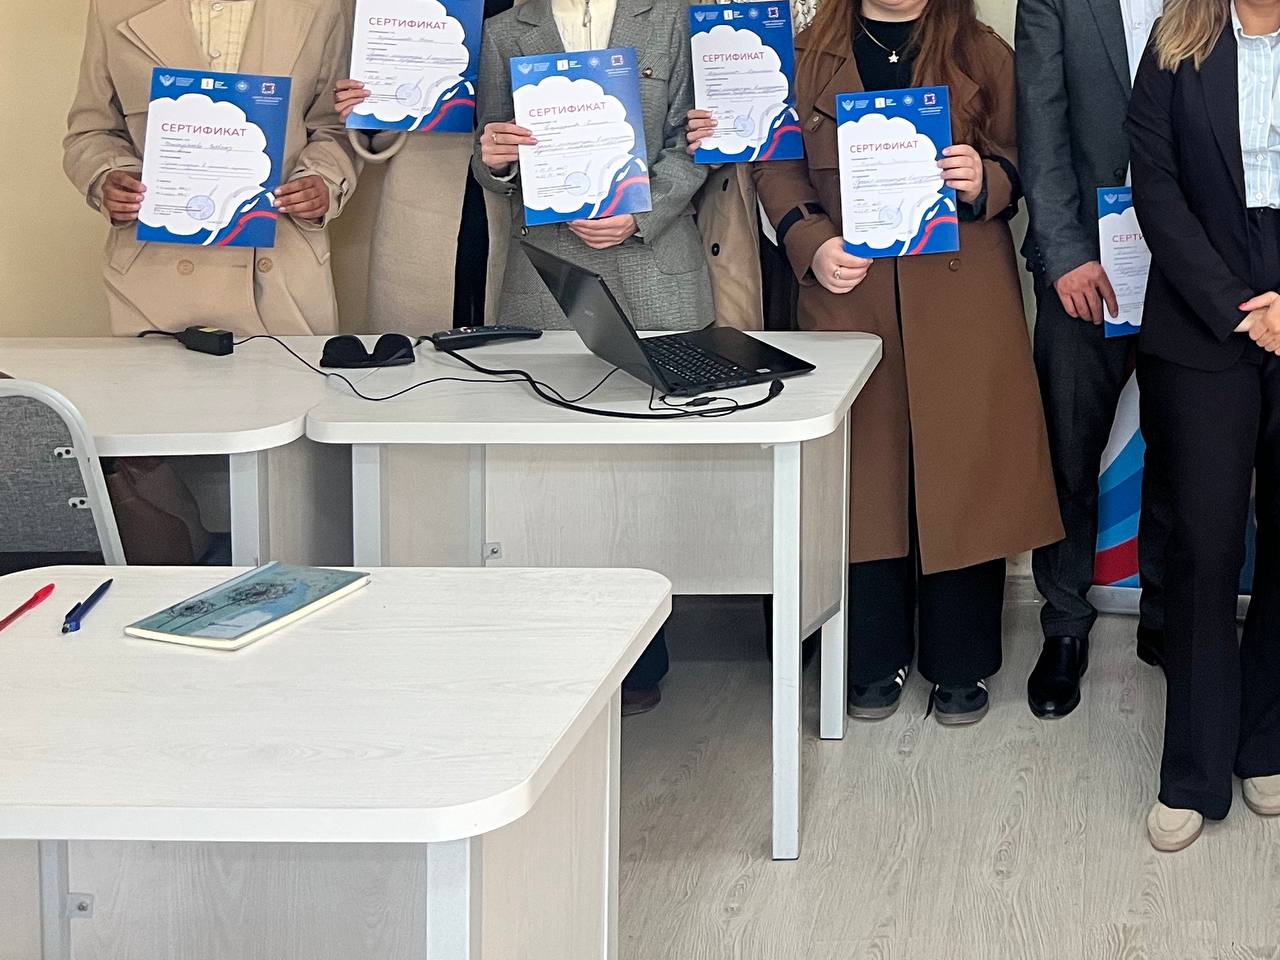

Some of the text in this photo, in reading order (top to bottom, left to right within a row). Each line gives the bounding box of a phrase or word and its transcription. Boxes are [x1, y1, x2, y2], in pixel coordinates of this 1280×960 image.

[368, 17, 448, 30] СЕРТИФИКАТ
[702, 51, 765, 63] СЕРТИФИКАТ
[528, 101, 608, 118] СЕРТИФИКАТ
[161, 122, 248, 137] СЕРТИФИКАТ
[849, 140, 919, 154] СЕРТИФИКАТ
